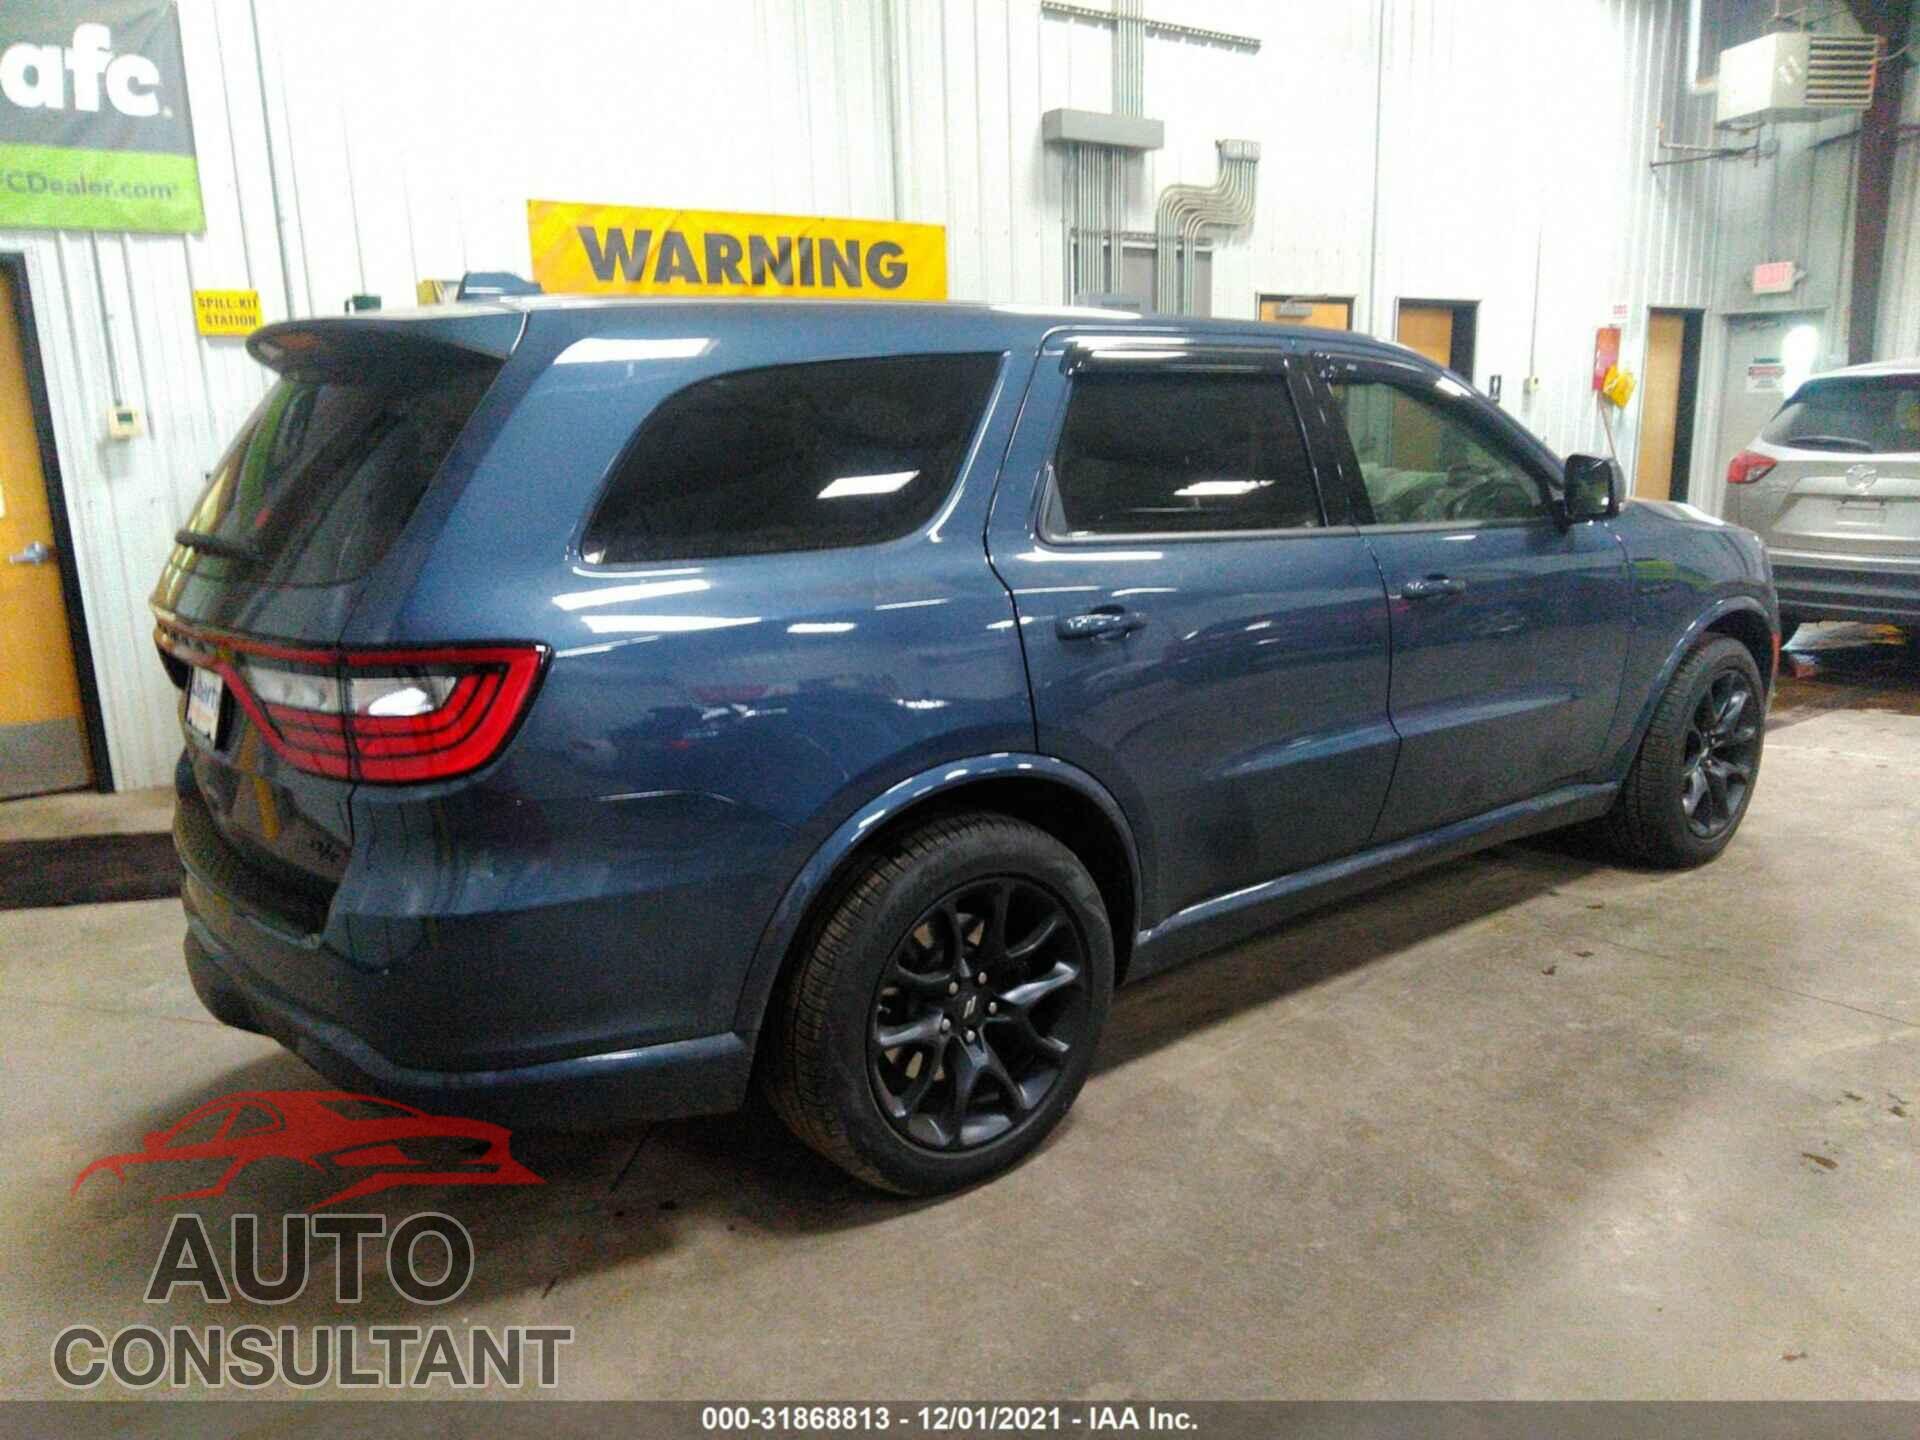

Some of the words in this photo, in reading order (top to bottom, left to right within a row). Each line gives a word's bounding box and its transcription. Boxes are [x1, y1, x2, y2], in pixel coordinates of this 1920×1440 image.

[578, 226, 908, 290] WARNING
[198, 297, 232, 309] SPILL
[206, 314, 256, 327] STATION
